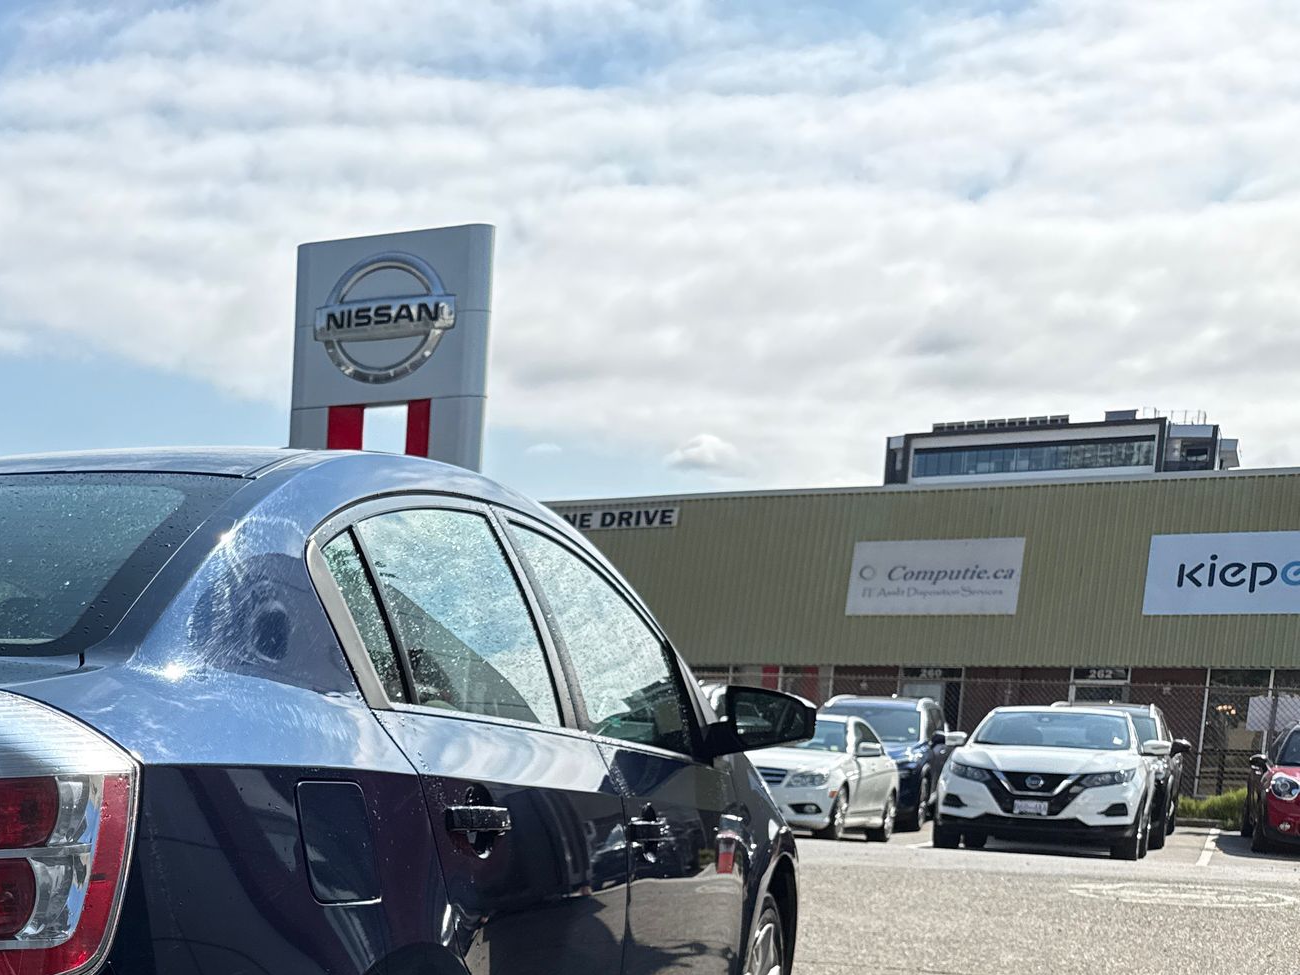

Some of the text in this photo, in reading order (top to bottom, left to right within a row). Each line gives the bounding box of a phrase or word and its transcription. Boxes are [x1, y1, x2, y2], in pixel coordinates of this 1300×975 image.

[327, 302, 441, 331] NISSAN
[600, 509, 675, 528] DRIVE
[887, 564, 1015, 586] Computie.ca
[1089, 669, 1114, 679] 262
